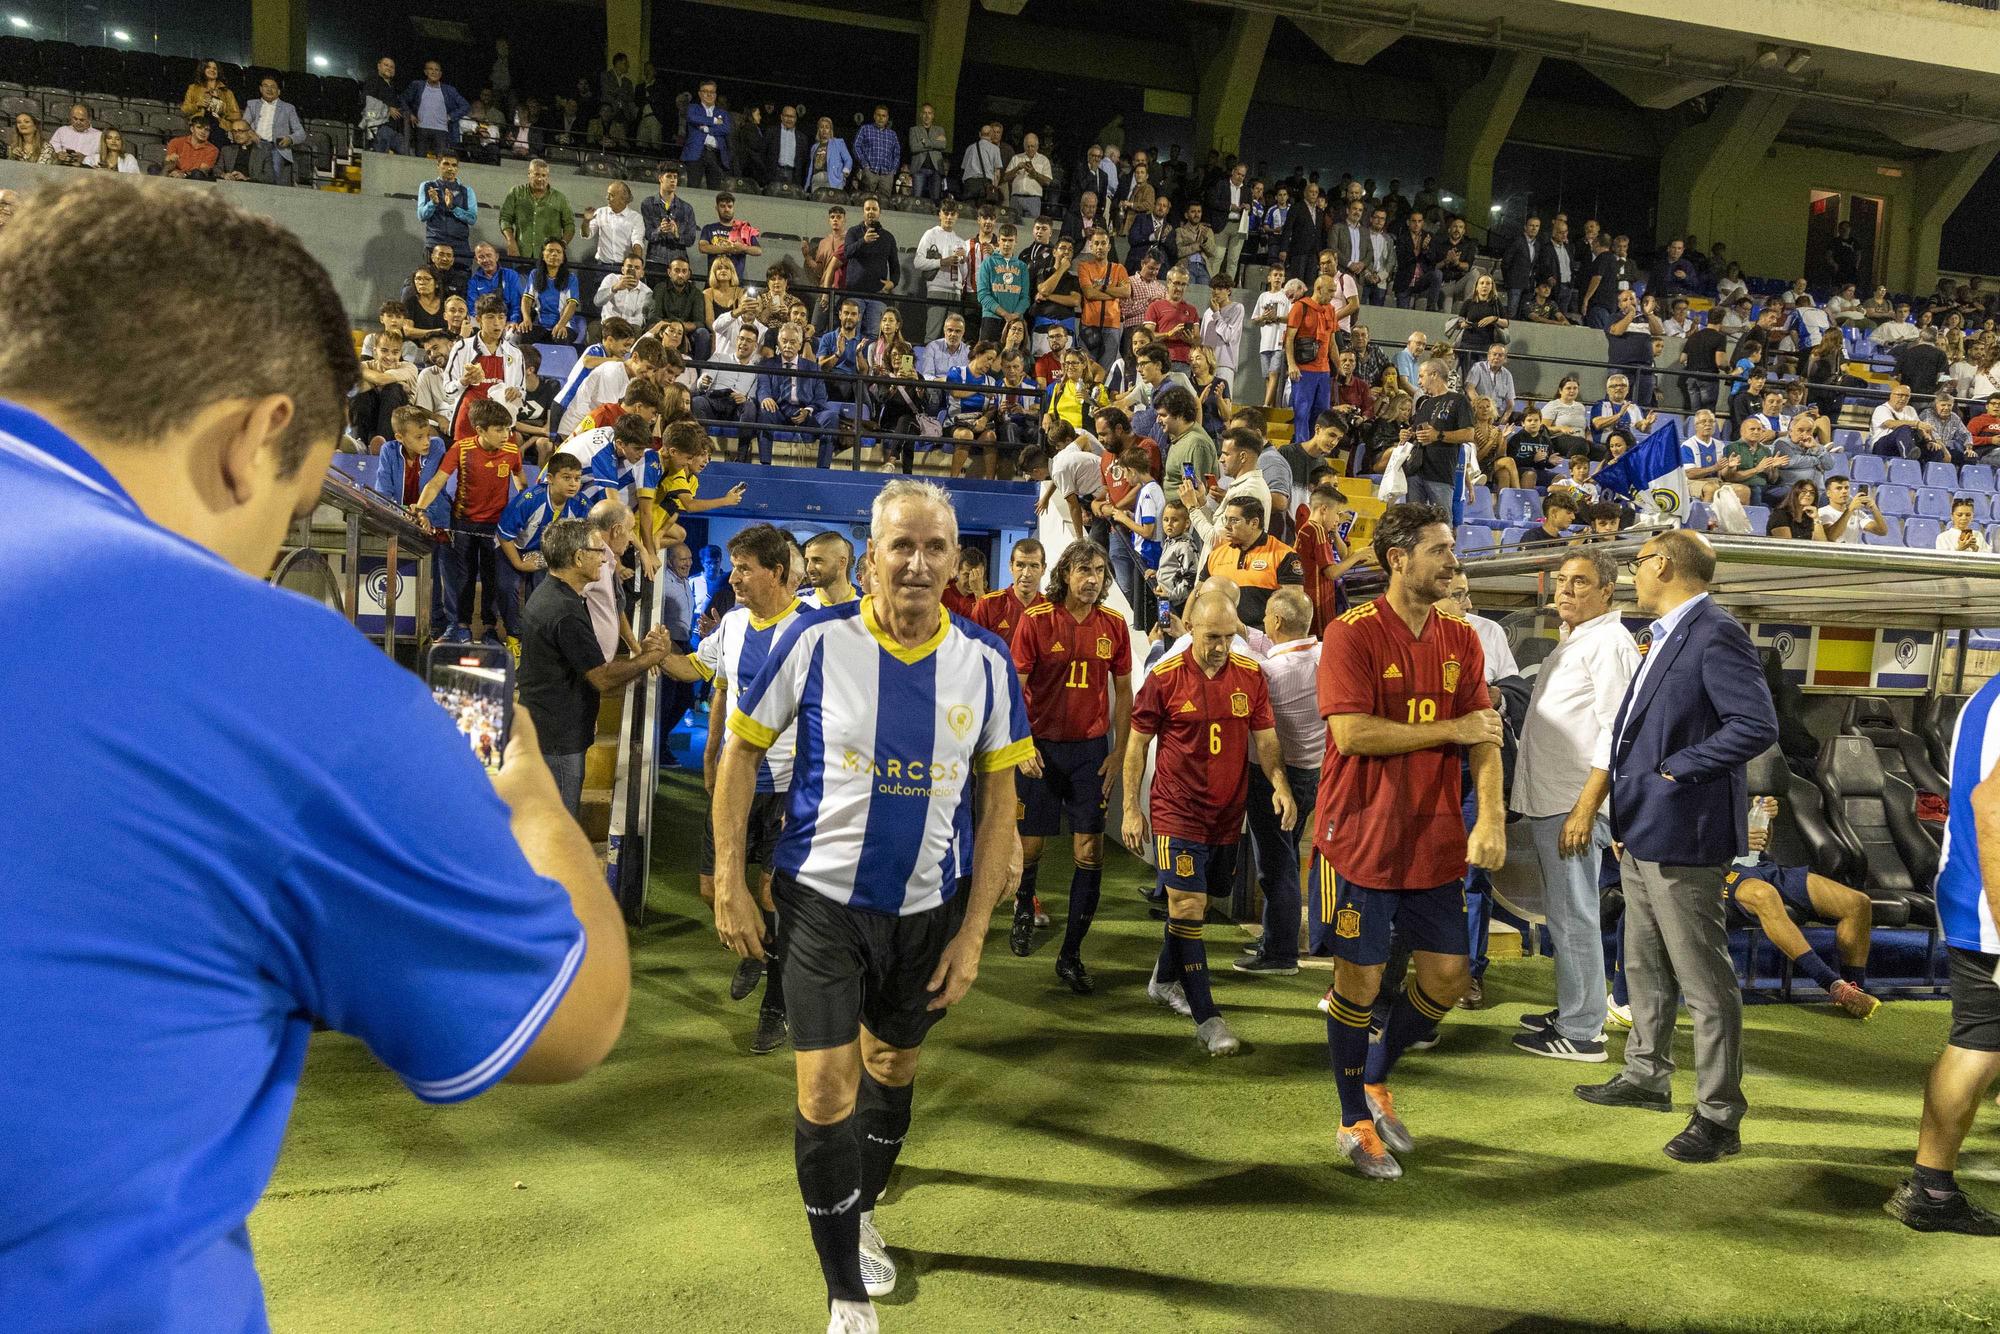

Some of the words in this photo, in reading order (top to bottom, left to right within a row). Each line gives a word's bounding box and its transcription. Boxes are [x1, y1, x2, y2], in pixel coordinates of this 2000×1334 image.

[1065, 660, 1089, 689] 11
[1209, 723, 1222, 755] 6
[841, 750, 960, 781] MARCOS
